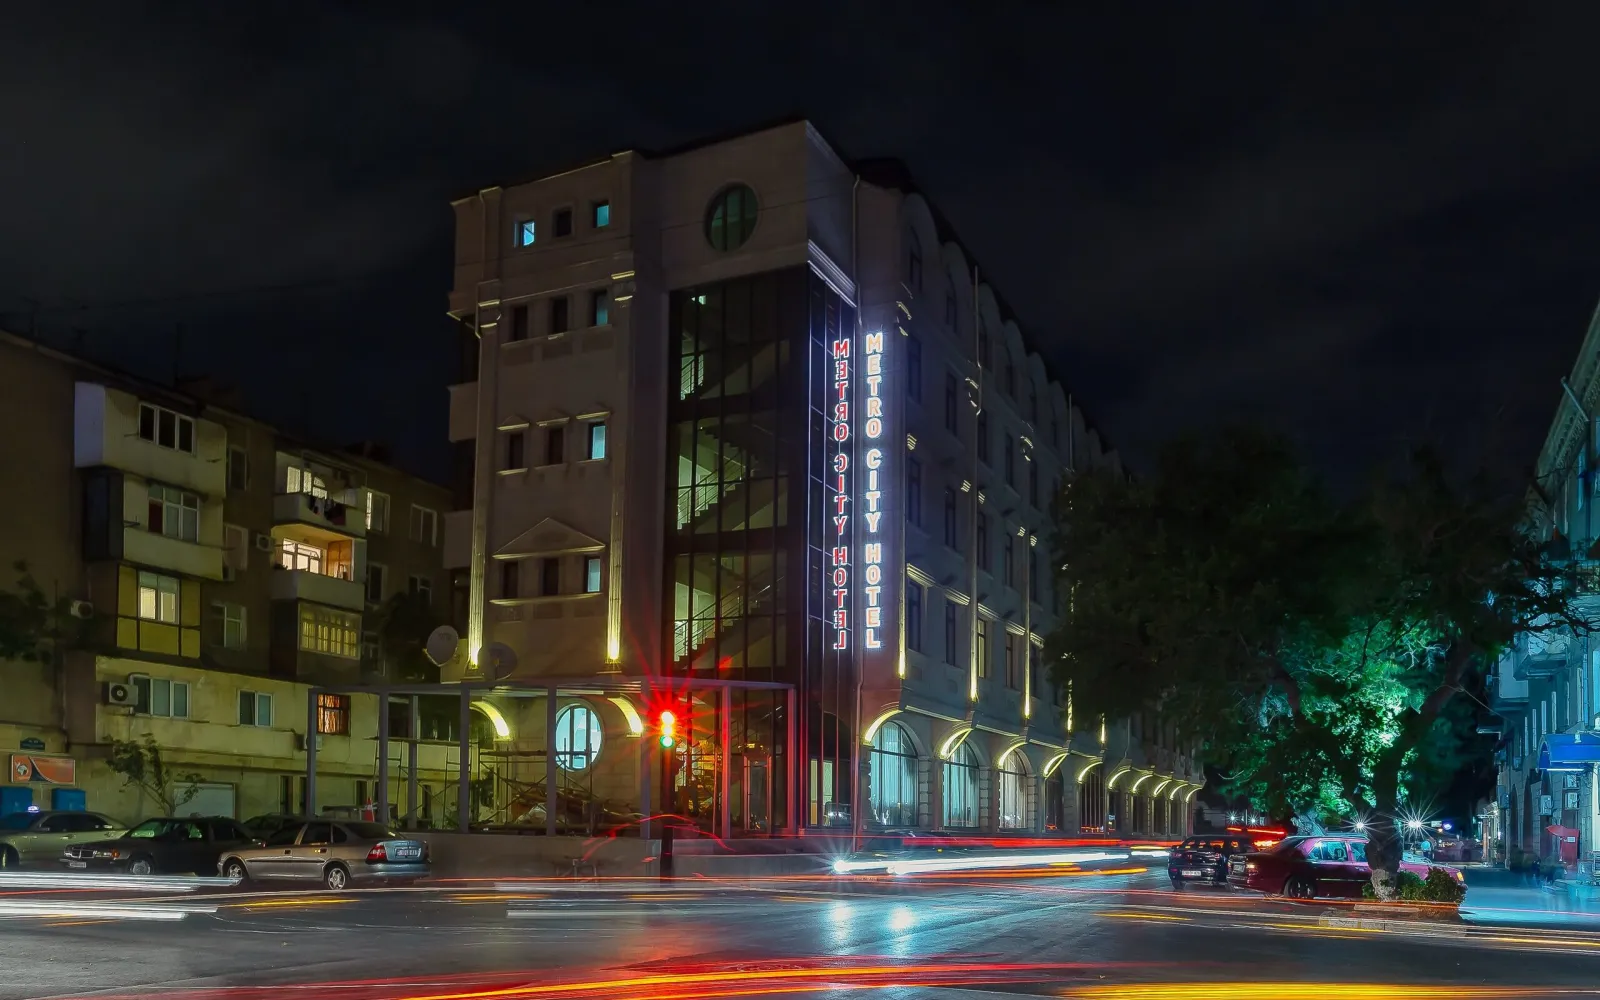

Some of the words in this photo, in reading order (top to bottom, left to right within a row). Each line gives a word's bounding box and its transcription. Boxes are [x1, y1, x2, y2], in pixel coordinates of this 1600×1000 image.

[865, 332, 883, 438] METRO
[865, 448, 882, 533] CITY
[865, 543, 881, 649] HOTEL
